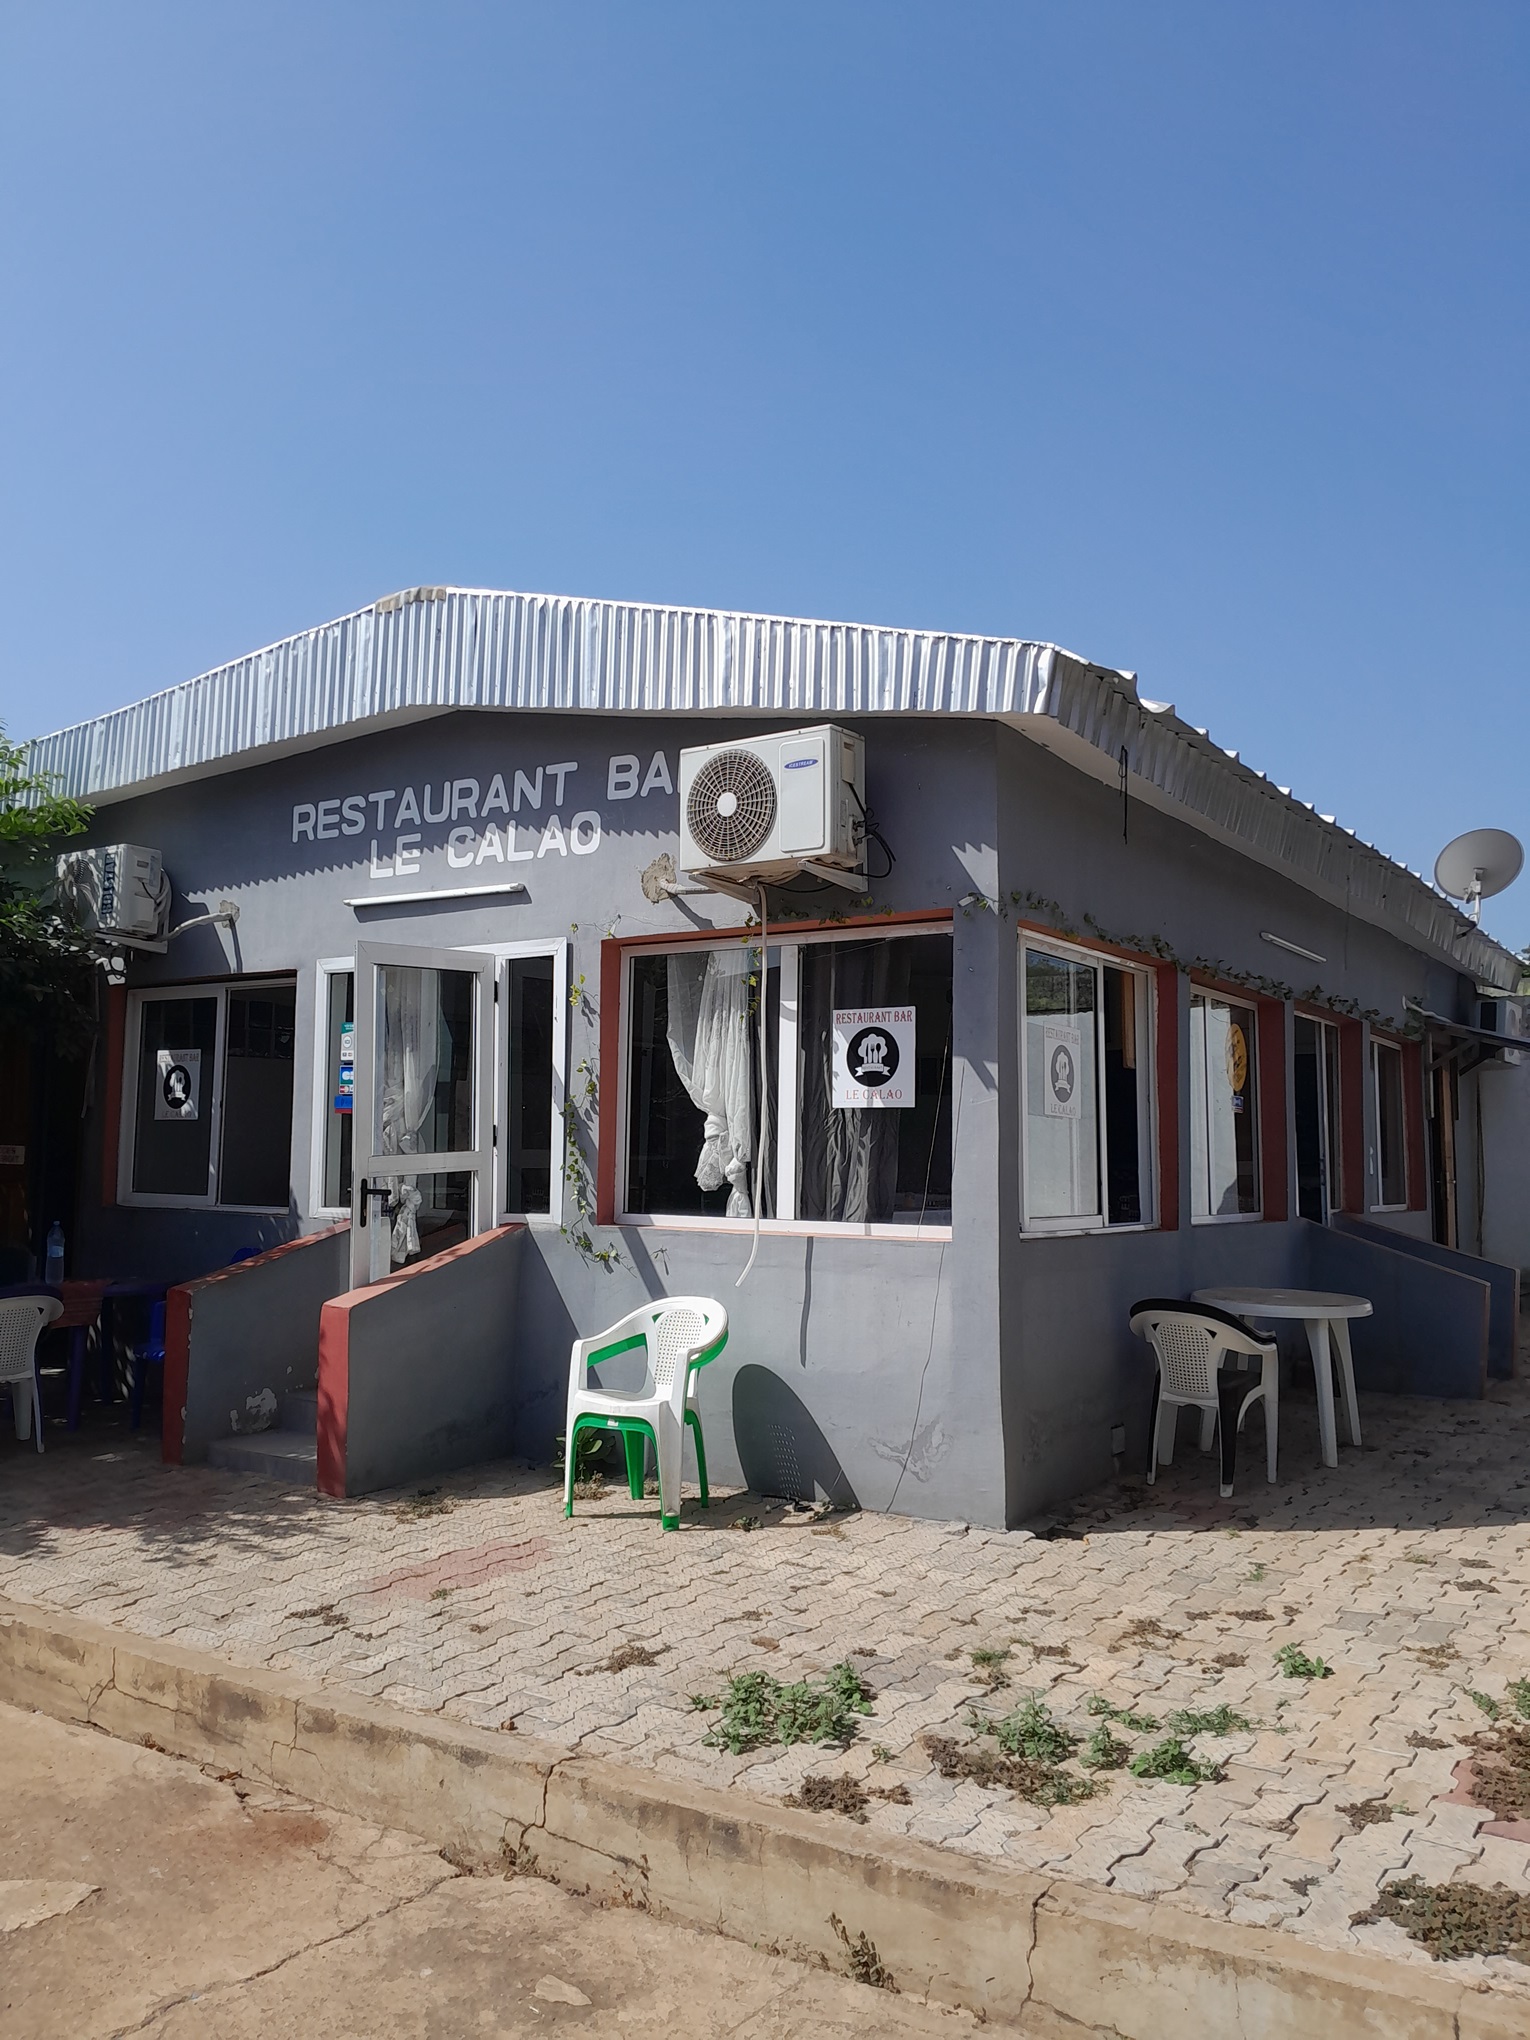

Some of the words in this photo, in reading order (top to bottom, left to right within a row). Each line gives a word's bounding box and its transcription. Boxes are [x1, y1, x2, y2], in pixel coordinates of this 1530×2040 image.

[292, 761, 578, 843] RESTAURANT
[606, 750, 681, 800] BA
[369, 832, 421, 879] LE
[447, 810, 601, 869] CALAO
[836, 1011, 892, 1024] RESTAURANT
[894, 1010, 913, 1022] BAR
[846, 1090, 859, 1100] LE
[863, 1089, 903, 1100] CALAO
